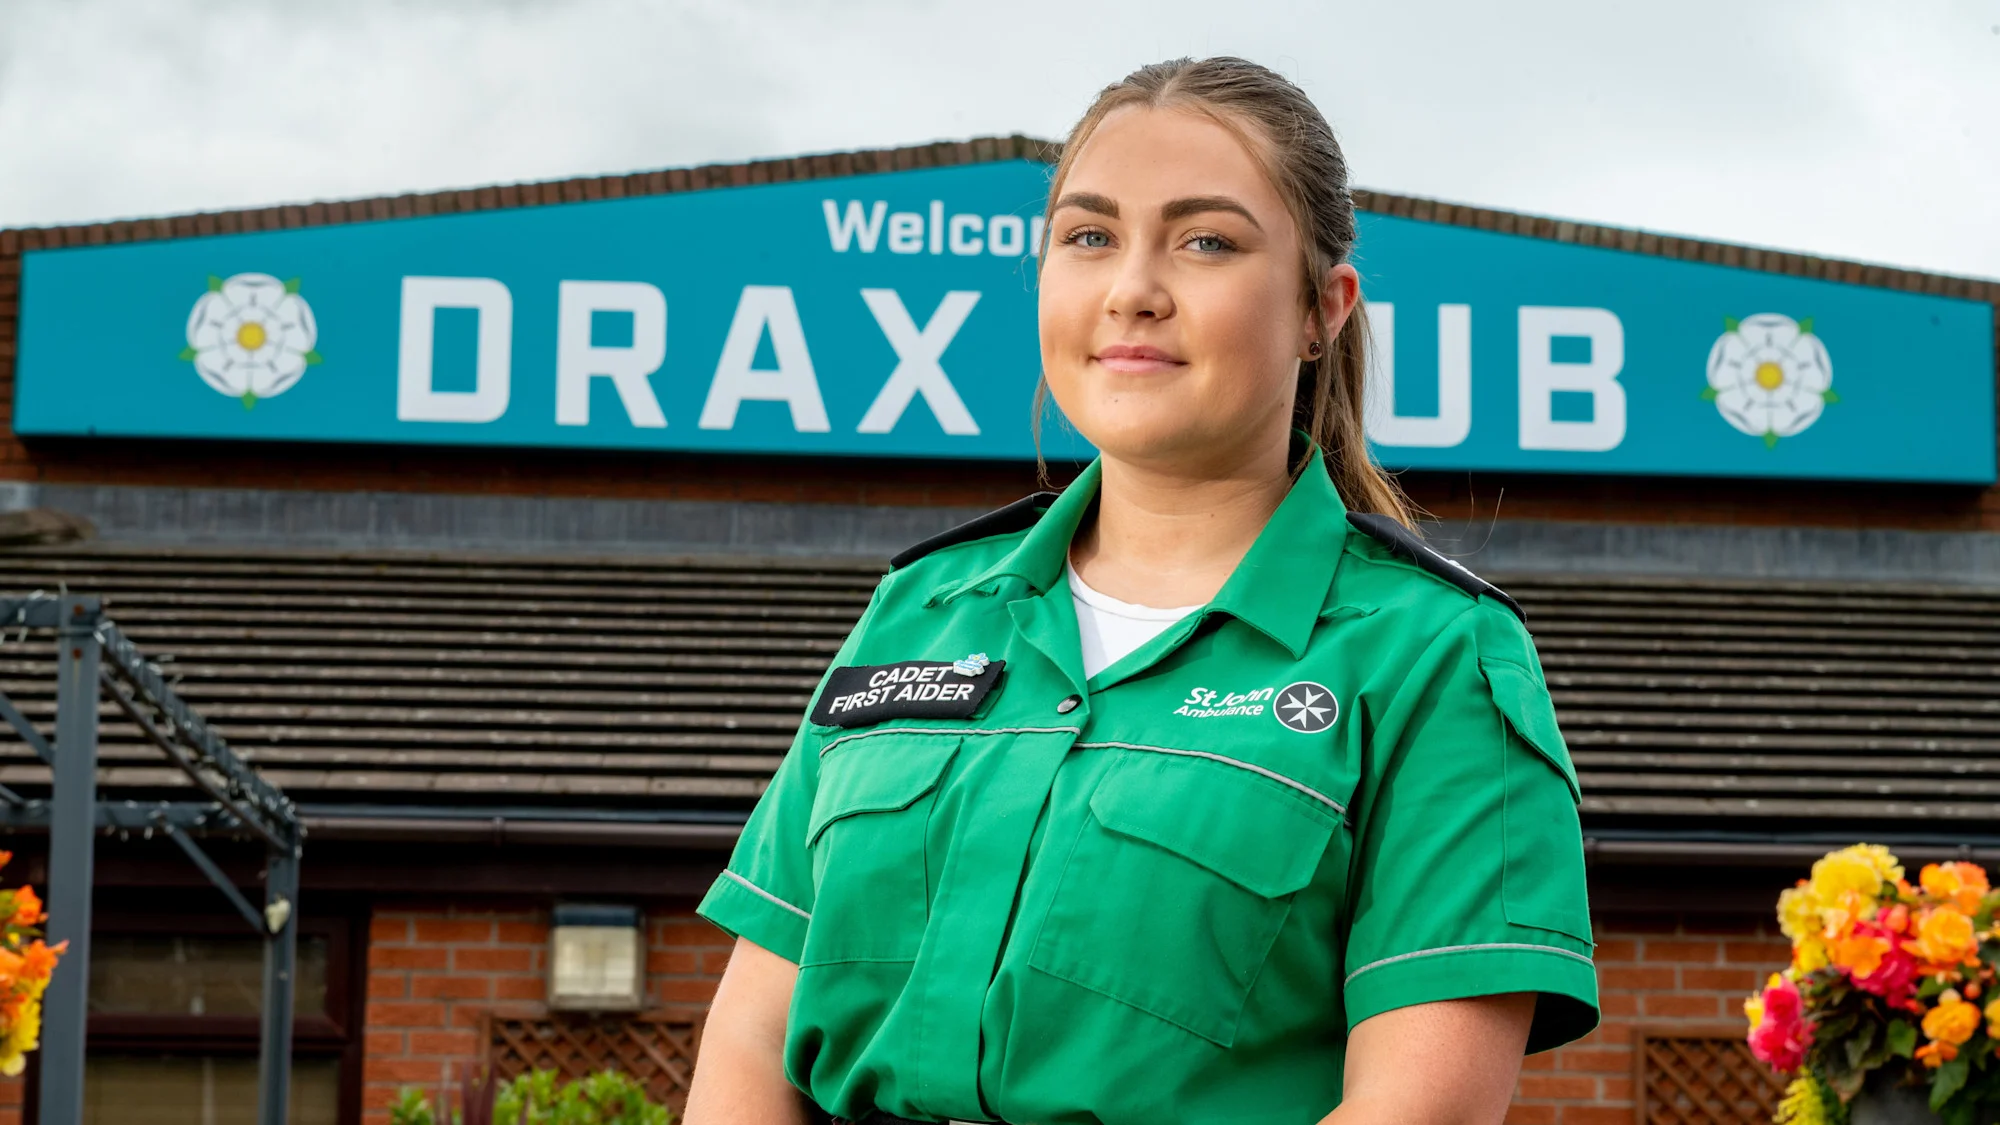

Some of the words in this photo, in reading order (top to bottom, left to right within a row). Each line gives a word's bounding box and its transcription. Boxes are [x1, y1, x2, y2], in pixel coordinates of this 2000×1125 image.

[822, 199, 1048, 257] Welco
[397, 275, 982, 436] DRAX
[1363, 301, 1627, 452] UB
[869, 666, 953, 688] CADET
[828, 684, 896, 714] FIRST
[893, 684, 975, 701] AIDER
[1184, 687, 1217, 707] St
[1213, 687, 1274, 707] John
[1173, 704, 1264, 718] Ambulance
